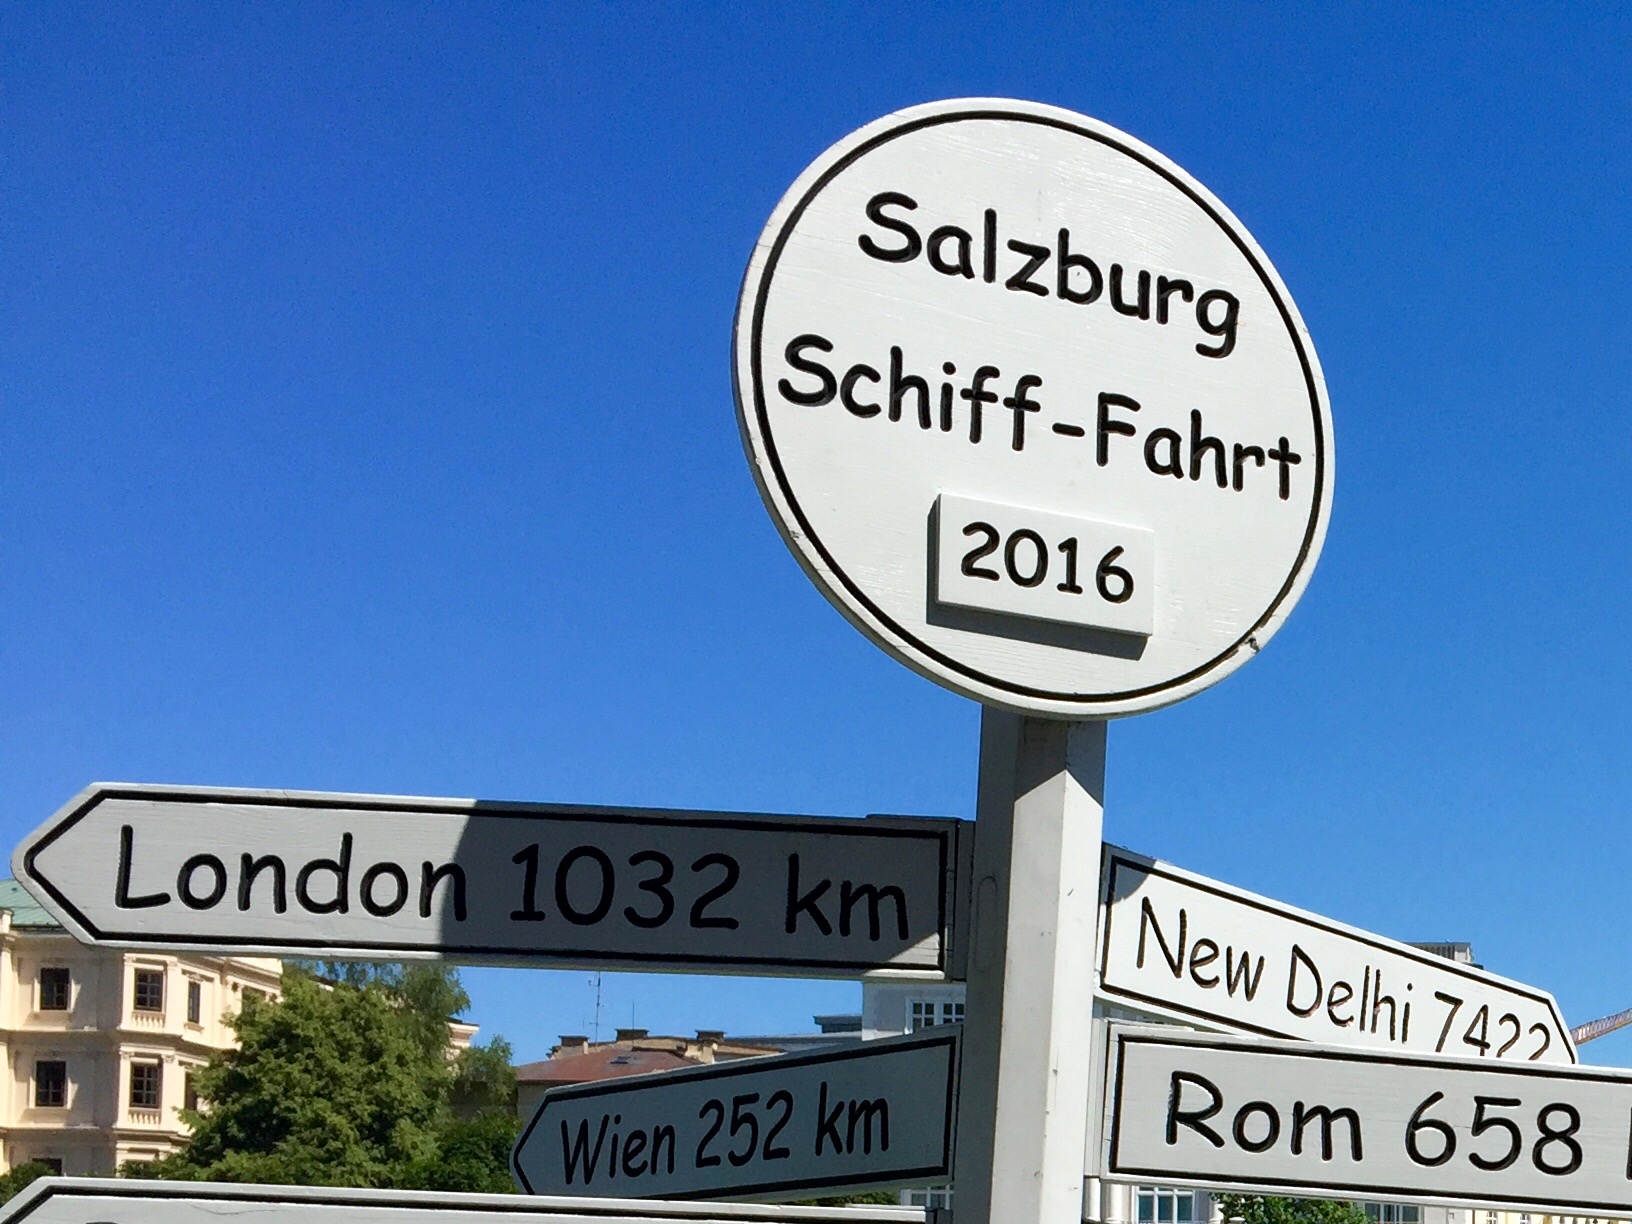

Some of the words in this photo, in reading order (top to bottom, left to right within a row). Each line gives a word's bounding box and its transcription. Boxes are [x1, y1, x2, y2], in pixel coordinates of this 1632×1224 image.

[858, 191, 1240, 359] Salzburg
[777, 333, 1302, 501] Schiff-Fahrt
[960, 521, 1135, 604] 2016
[116, 825, 469, 924] London
[509, 842, 740, 931] 1032
[784, 852, 911, 942] km
[1136, 896, 1265, 1002] New
[1285, 942, 1412, 1044] Delhi
[1433, 990, 1551, 1061] 7422
[560, 1113, 676, 1186] Wien
[694, 1089, 794, 1169] 252
[814, 1080, 890, 1157] km
[1165, 1070, 1363, 1162] Rom
[1404, 1090, 1583, 1176] 658
